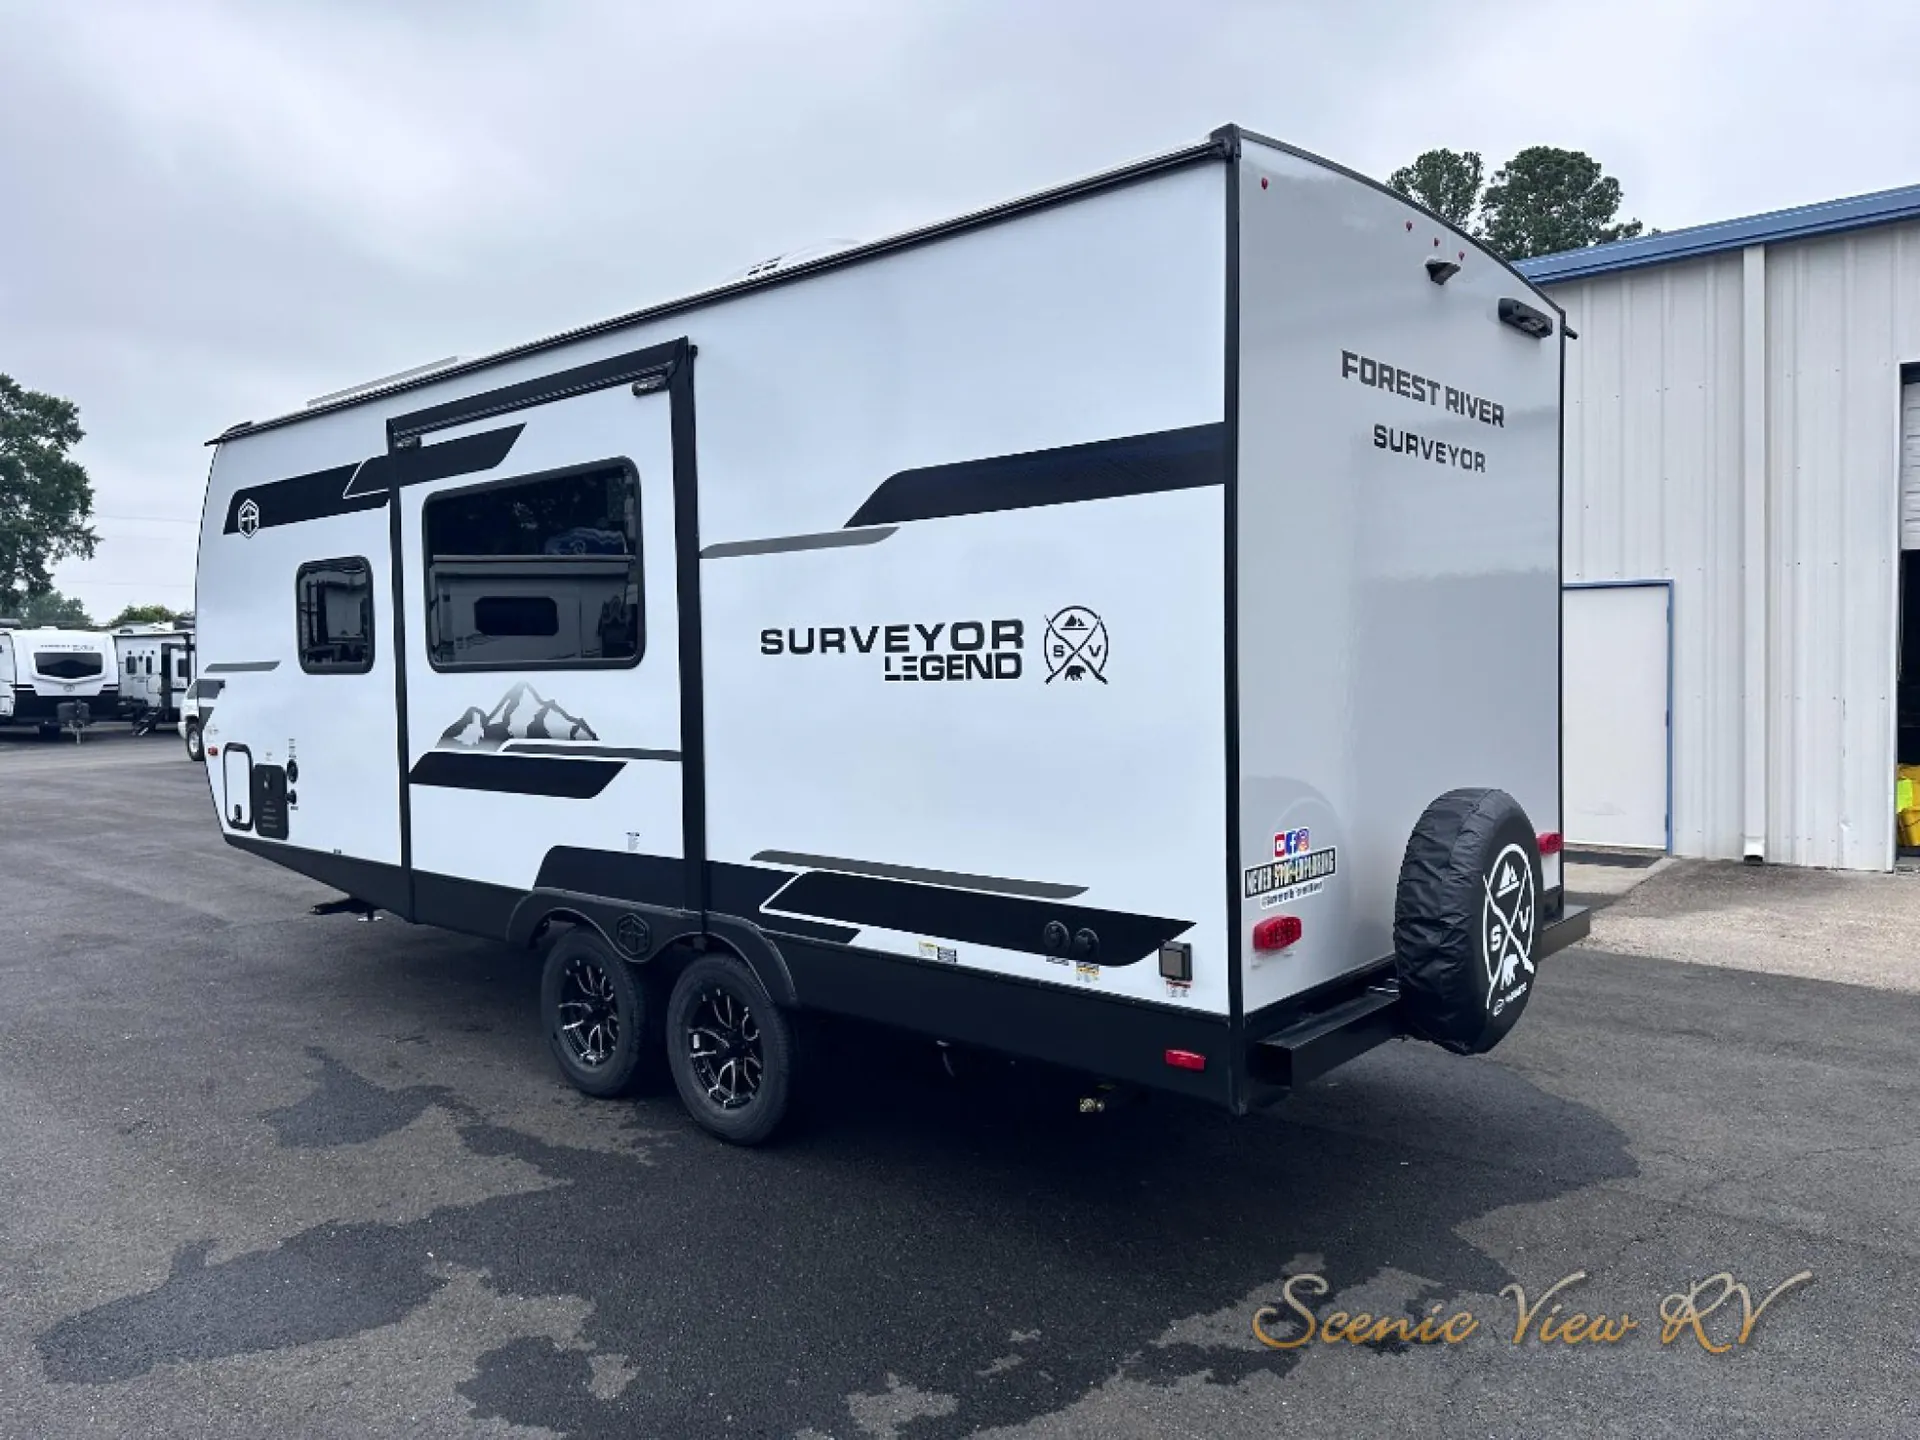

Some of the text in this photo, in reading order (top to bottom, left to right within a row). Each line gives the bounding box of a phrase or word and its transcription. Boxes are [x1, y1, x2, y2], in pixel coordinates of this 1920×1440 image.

[1341, 349, 1505, 428] FOREST RIVER
[1373, 423, 1486, 473] SURVEYOR
[760, 618, 1024, 655] SURVEYOR
[884, 652, 1023, 681] LEGEND
